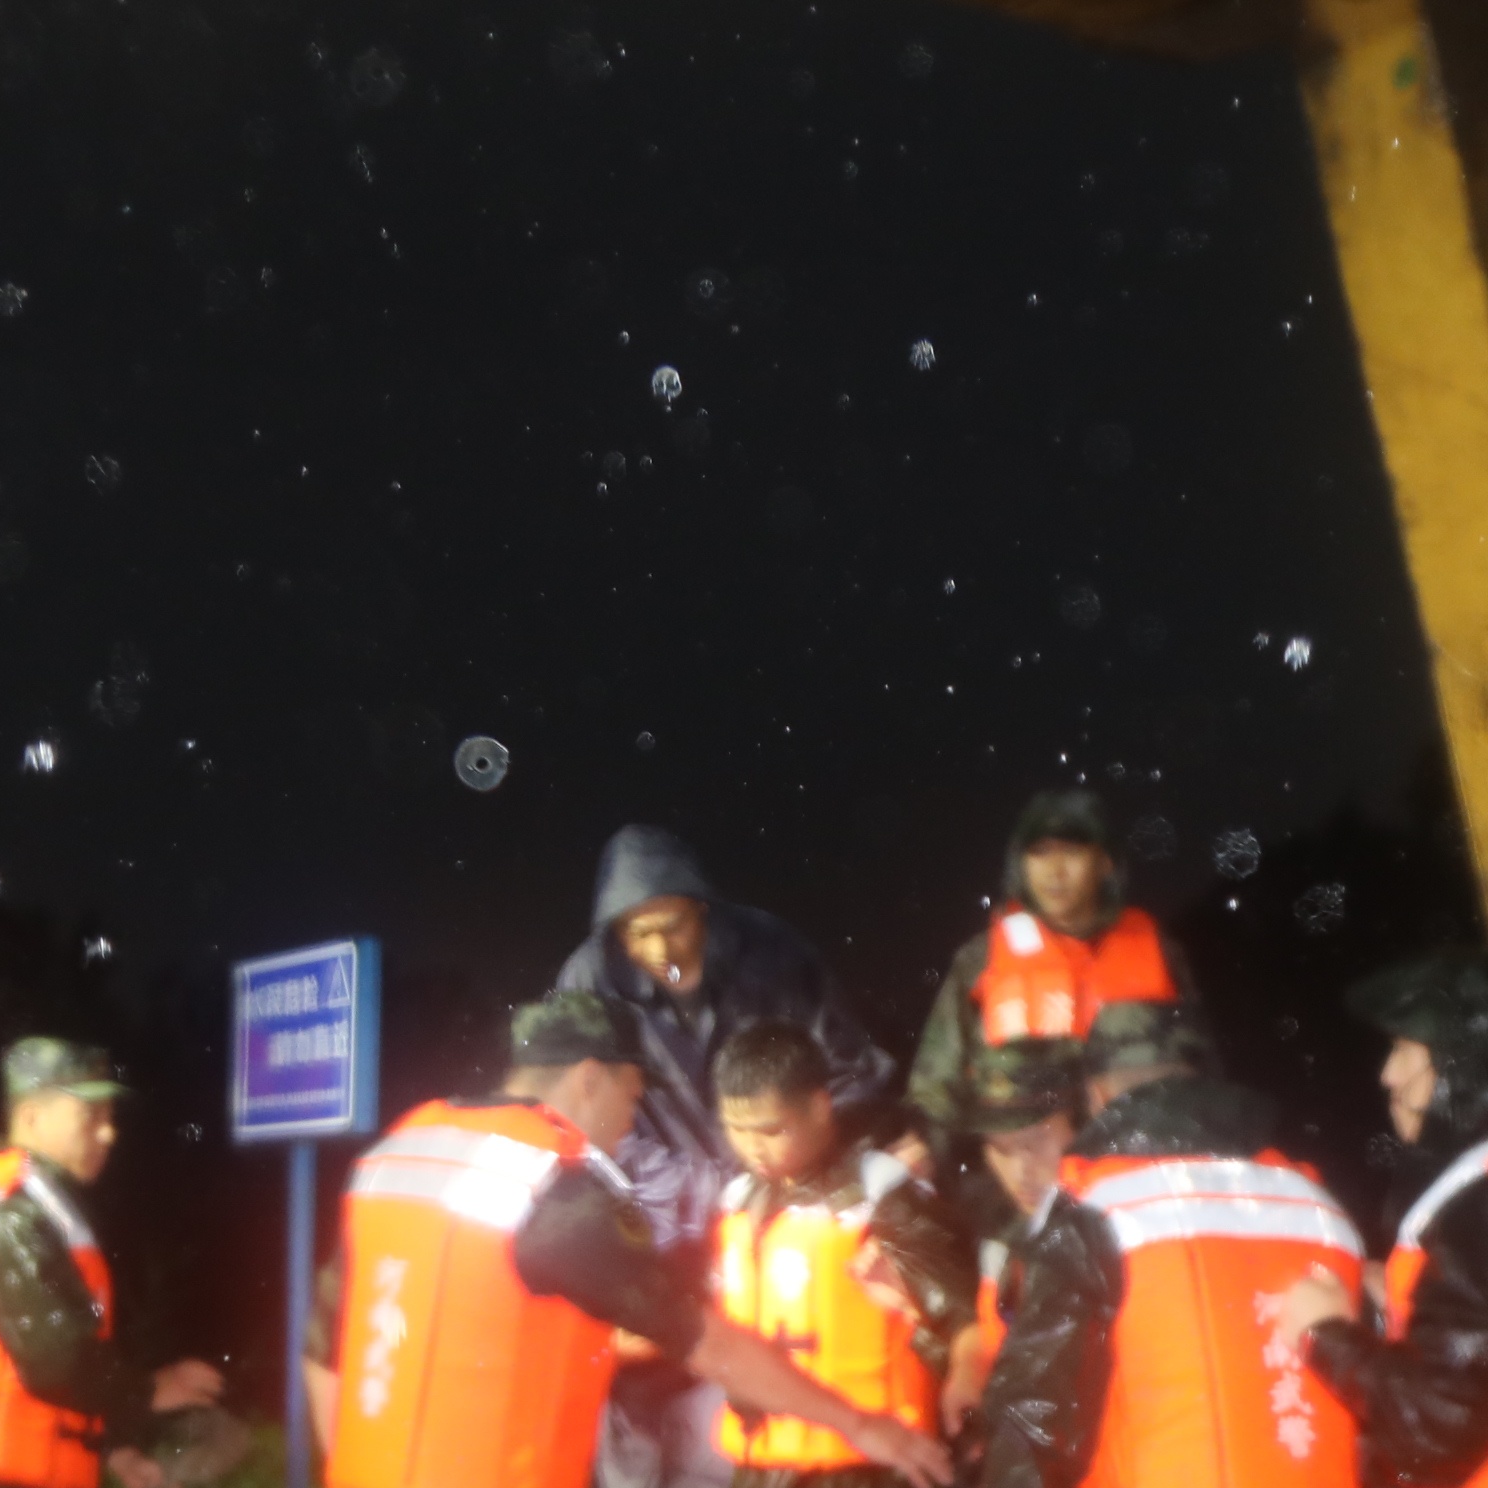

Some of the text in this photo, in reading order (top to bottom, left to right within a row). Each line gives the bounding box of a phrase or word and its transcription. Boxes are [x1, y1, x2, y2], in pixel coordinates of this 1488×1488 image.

[248, 974, 318, 1019] 水深危险
[269, 1019, 348, 1066] 请勿靠近
